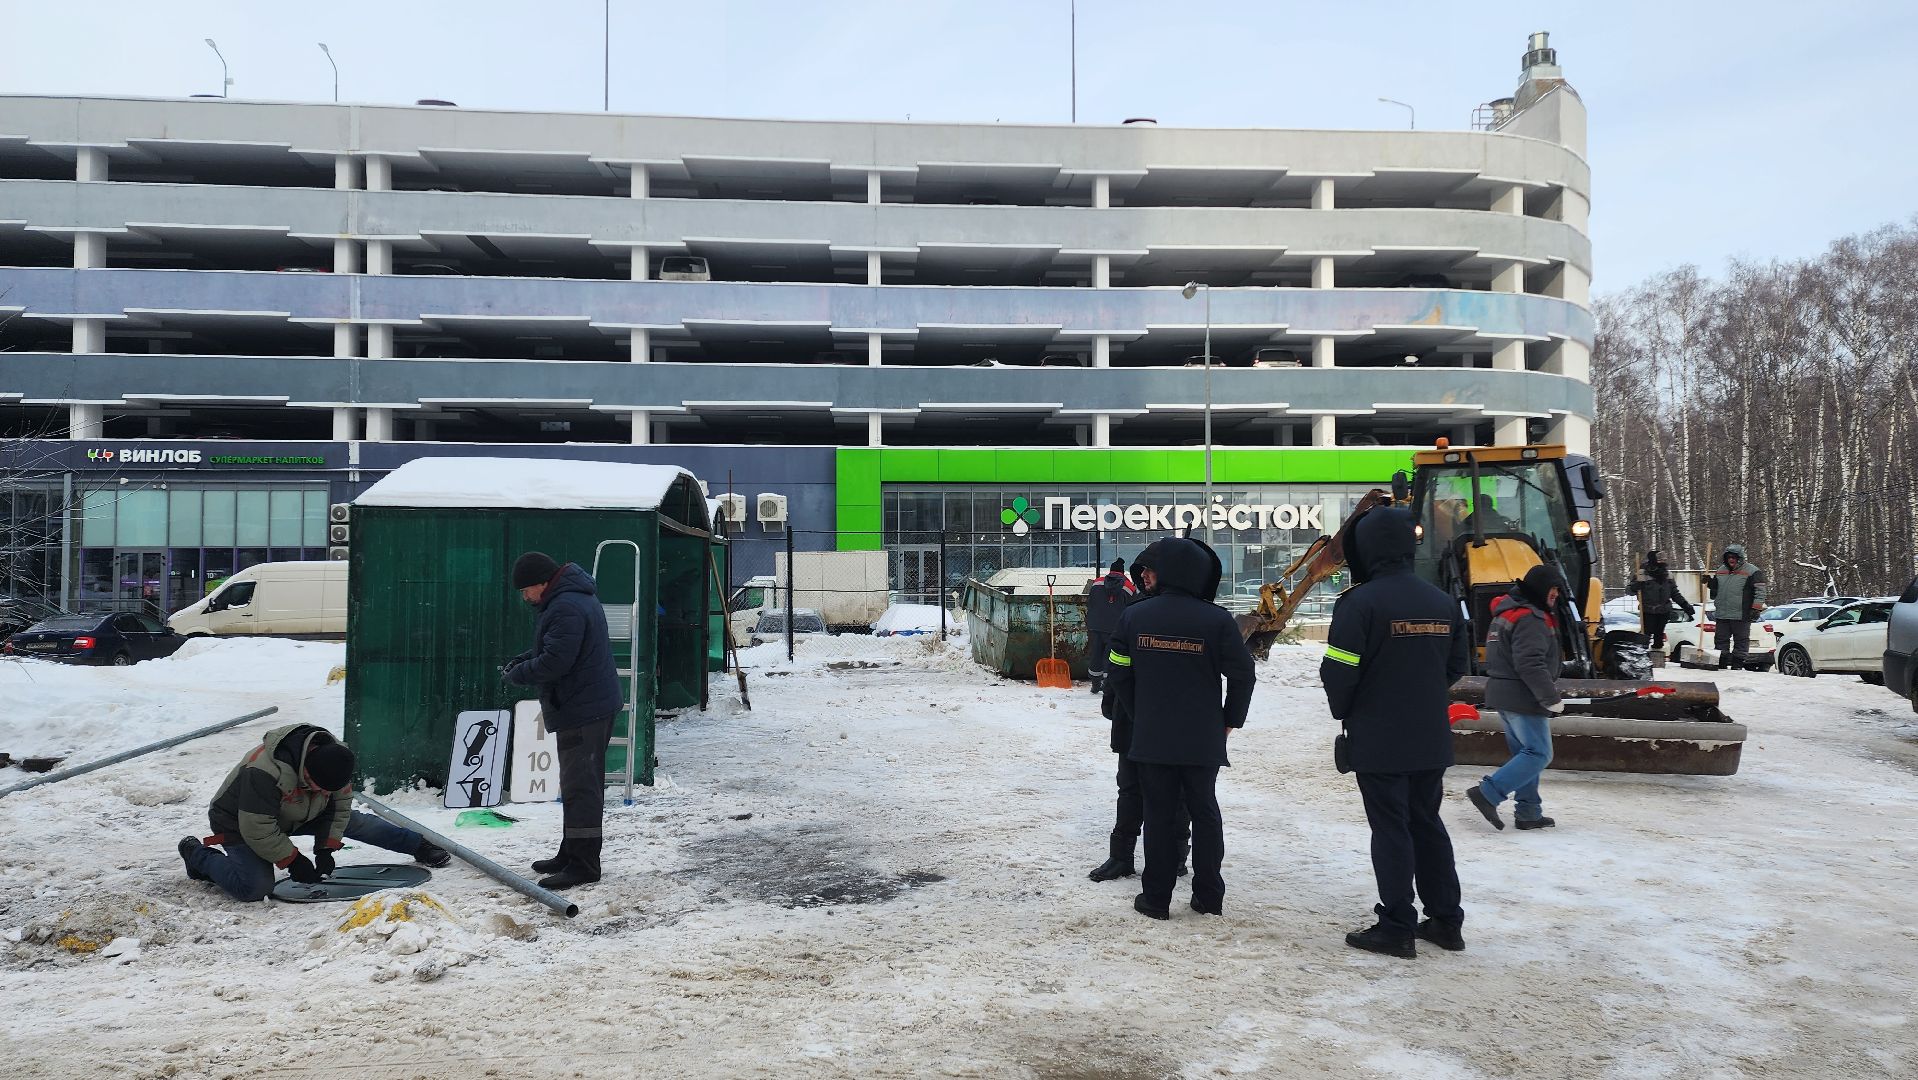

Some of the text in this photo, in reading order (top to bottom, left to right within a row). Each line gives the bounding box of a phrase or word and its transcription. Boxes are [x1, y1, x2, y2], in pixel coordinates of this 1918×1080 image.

[209, 456, 325, 464] СУПЕРМАРКЕТ НАПИТКОВ
[1044, 494, 1323, 539] Перекрёсток
[1150, 637, 1181, 650] Московской
[1181, 641, 1202, 652] области
[527, 751, 552, 772] 10
